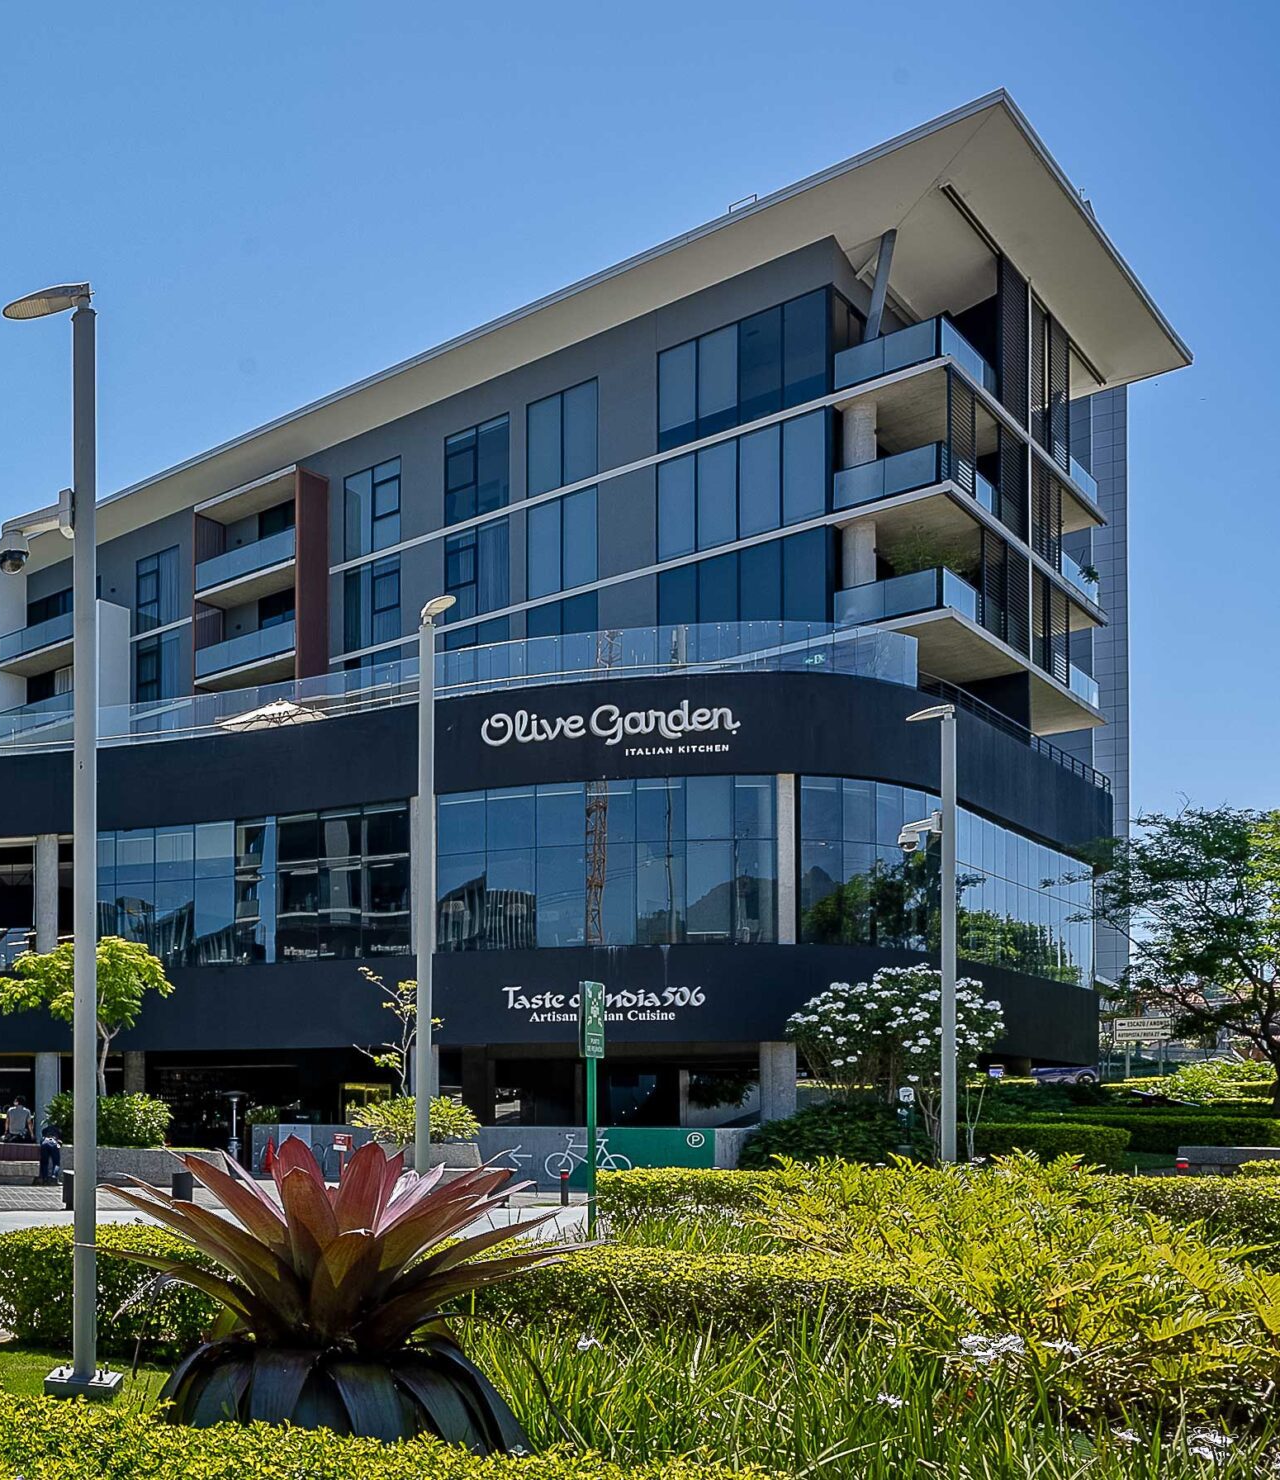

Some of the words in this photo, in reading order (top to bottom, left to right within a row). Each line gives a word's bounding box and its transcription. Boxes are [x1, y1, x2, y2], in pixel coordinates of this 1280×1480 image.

[481, 710, 586, 746] Olive
[625, 747, 673, 757] ITALIAN
[678, 744, 730, 754] KITCHEN
[502, 986, 565, 1009] Taste
[603, 988, 661, 1008] ndia
[529, 1011, 578, 1022] Artisan
[627, 1010, 676, 1021] Cuisine
